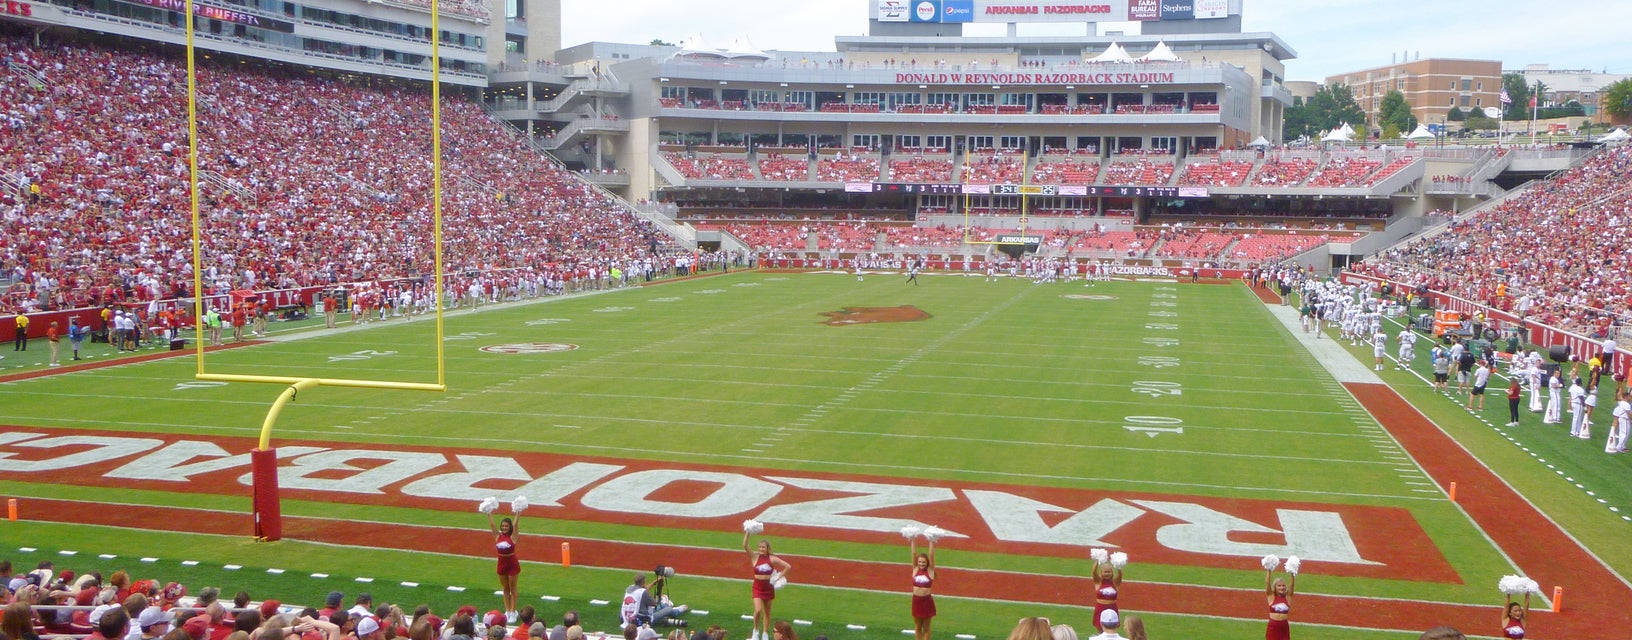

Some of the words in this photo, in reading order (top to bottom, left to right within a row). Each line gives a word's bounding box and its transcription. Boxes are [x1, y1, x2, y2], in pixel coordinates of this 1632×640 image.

[985, 6, 1039, 14] ARKANSAS
[1043, 5, 1111, 14] RAZORBACKS
[1163, 4, 1192, 13] Stephens
[896, 73, 948, 84] DONALD
[950, 73, 962, 83] W
[965, 73, 1032, 84] REYNOLDS
[1034, 73, 1114, 84] RAZORBACK
[1115, 72, 1174, 84] STADIUM
[1001, 236, 1039, 244] ARKANSAS
[1108, 266, 1168, 276] AZORBACKS
[0, 431, 1387, 567] RAZORBAC
